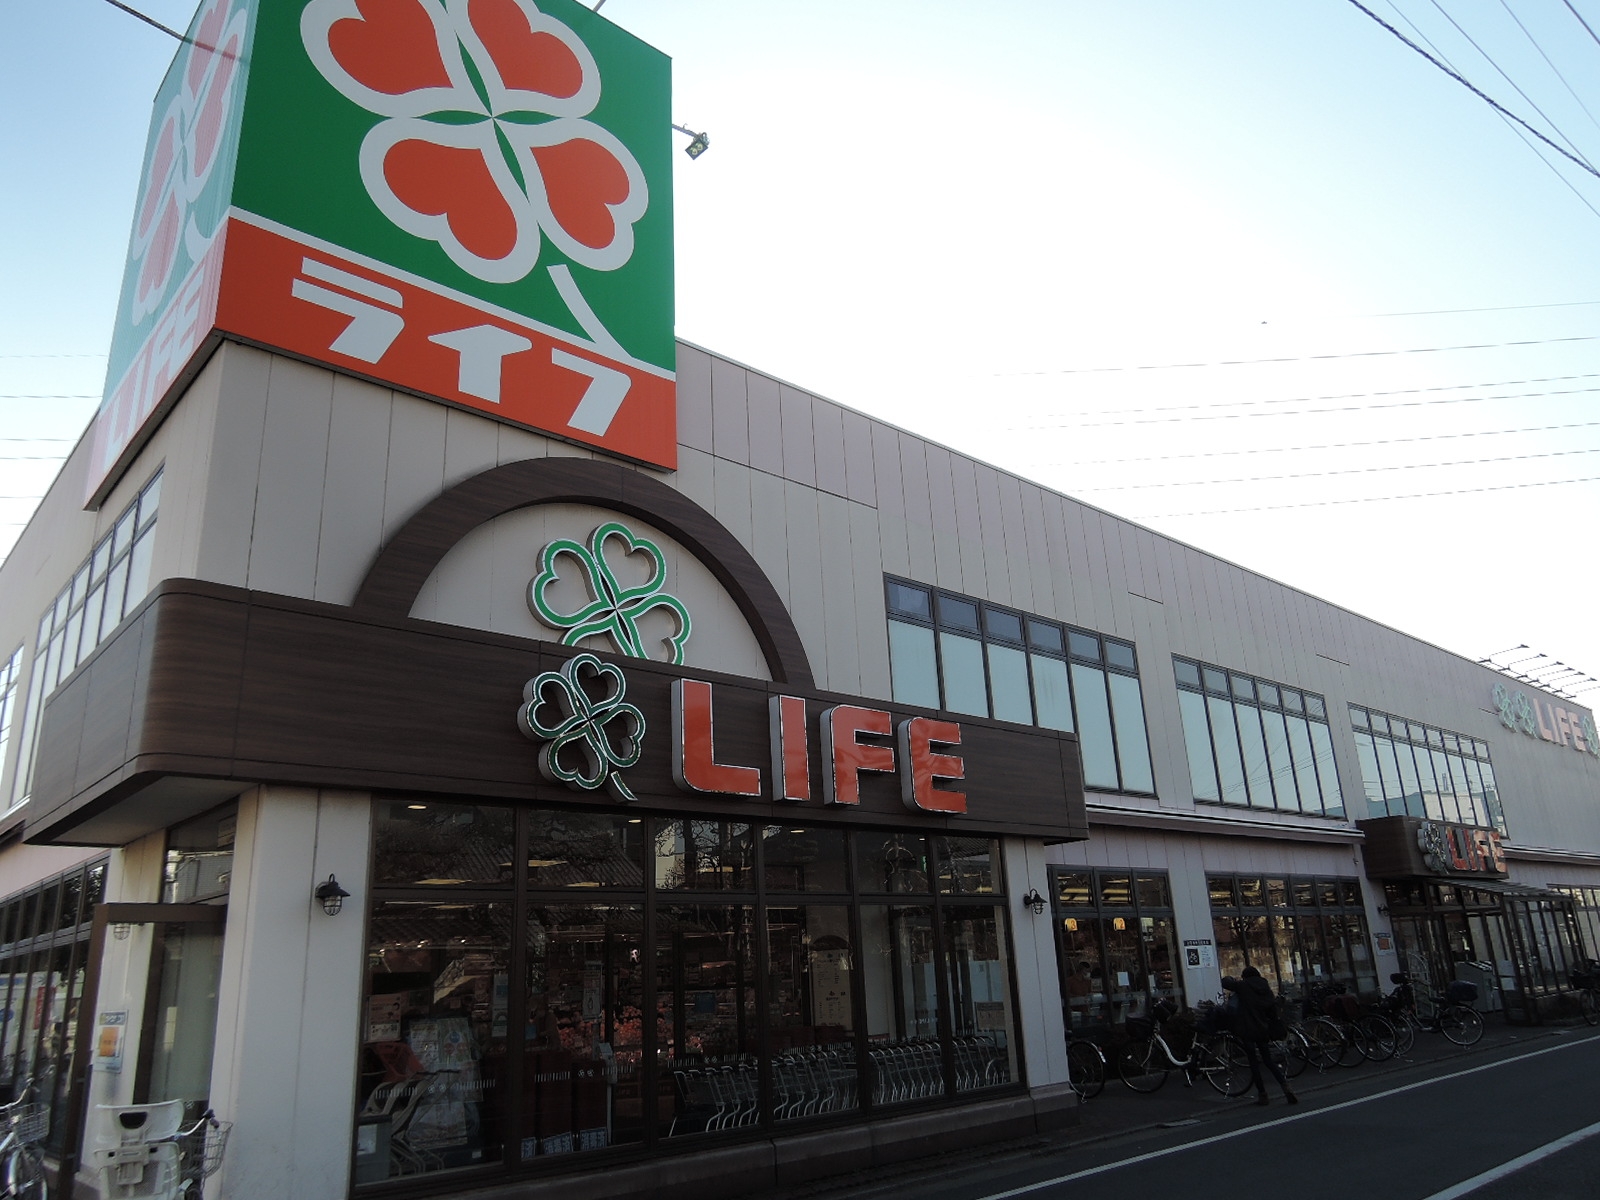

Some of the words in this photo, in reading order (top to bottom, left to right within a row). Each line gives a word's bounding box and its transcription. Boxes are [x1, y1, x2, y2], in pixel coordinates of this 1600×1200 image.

[104, 264, 205, 474] LIFE
[291, 256, 632, 437] ライフ
[672, 678, 967, 814] LIFE
[1533, 698, 1586, 751] LIFE
[1447, 826, 1507, 873] LIFE
